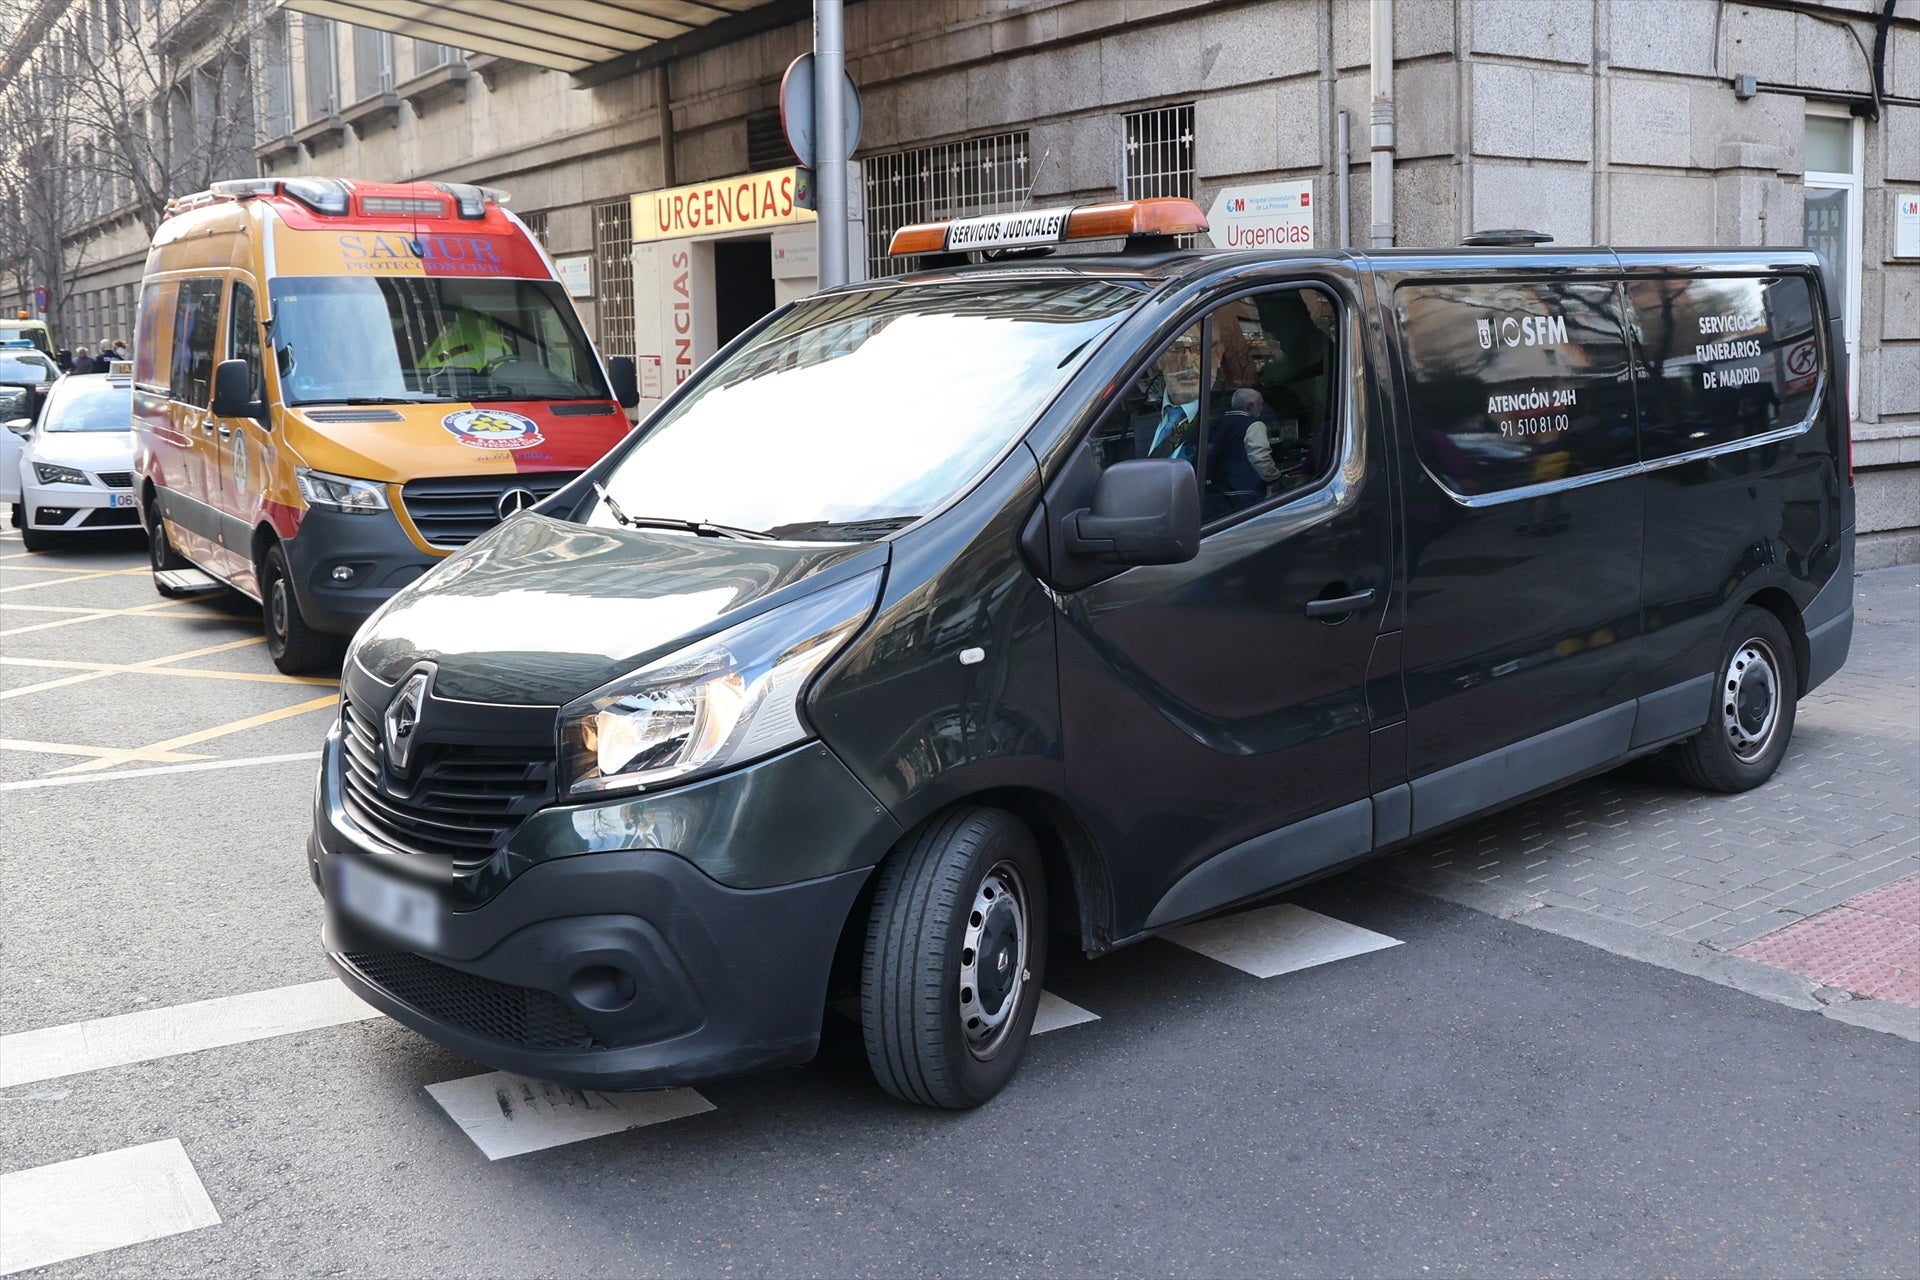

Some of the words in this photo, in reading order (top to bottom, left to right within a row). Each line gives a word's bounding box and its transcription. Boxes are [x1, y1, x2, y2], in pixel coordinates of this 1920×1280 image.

[658, 176, 793, 232] URGENCIAS
[952, 221, 1001, 244] SERVICIOS
[1003, 215, 1060, 239] JUDICIALES
[1227, 221, 1310, 248] Urgencias
[339, 234, 503, 263] SAMUR
[1698, 314, 1753, 334] SERVICIOS
[1695, 339, 1761, 362] FUNERARIOS
[1703, 371, 1717, 390] DE
[1720, 366, 1760, 388] MADRID
[1487, 387, 1550, 414] ATENCIÓN
[1552, 389, 1577, 407] 24H
[1500, 420, 1513, 438] 91
[1518, 417, 1538, 436] 510
[1540, 416, 1552, 433] 81
[1555, 414, 1569, 431] 00
